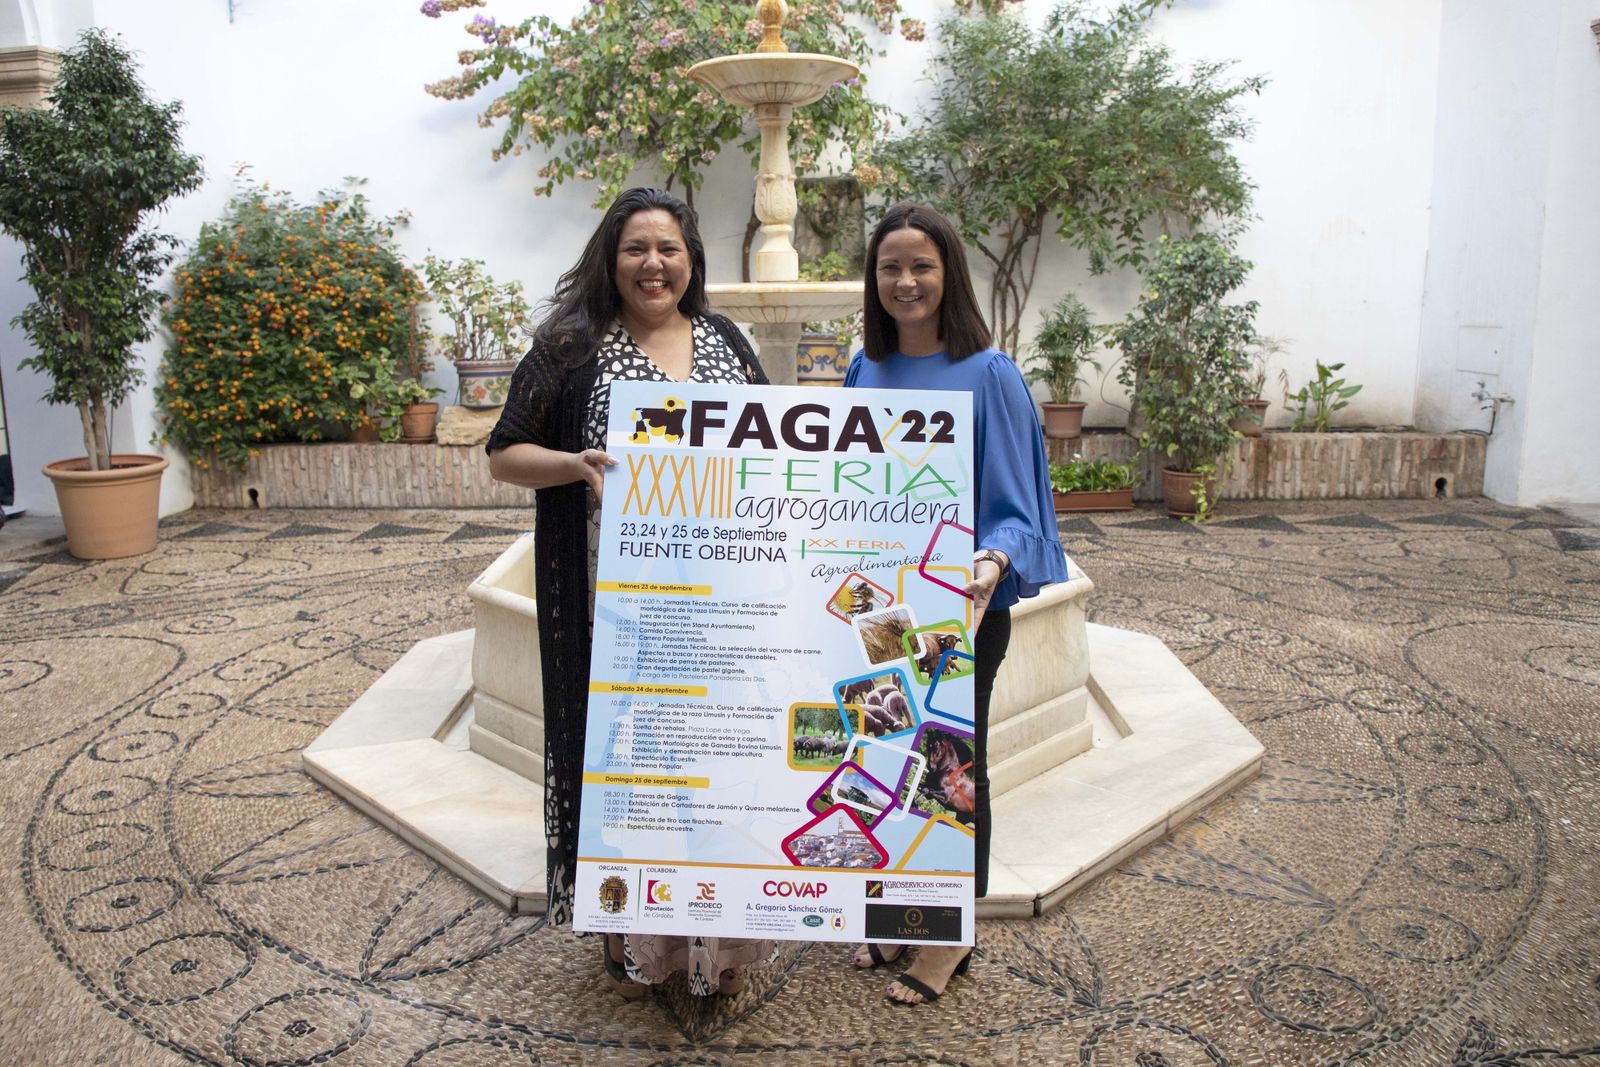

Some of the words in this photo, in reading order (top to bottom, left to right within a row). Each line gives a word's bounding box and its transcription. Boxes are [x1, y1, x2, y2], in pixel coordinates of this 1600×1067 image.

[689, 400, 885, 453] FAGA
[622, 454, 733, 519] XXXVIII
[736, 458, 959, 497] FERIA
[735, 493, 960, 530] agroganadera
[620, 522, 656, 538] 23,24
[660, 527, 668, 541] y
[672, 524, 688, 539] 25
[691, 525, 710, 540] de
[713, 526, 787, 545] Septiembre
[846, 540, 906, 551] FERIA
[619, 541, 692, 560] FUENTE
[698, 544, 787, 563] OBEJUNA
[811, 552, 944, 583] Agroalimentaria
[640, 605, 676, 613] morfológica
[639, 620, 679, 628] Inauguración
[710, 623, 755, 631] Ayuntamiento)
[653, 664, 691, 673] degustación
[654, 686, 688, 694] septiembre
[633, 709, 670, 717] morfológica
[675, 733, 717, 741] reproducción
[663, 740, 699, 748] Morfológico
[631, 754, 669, 762] Espectáculo
[605, 776, 633, 784] Domingo
[653, 778, 688, 786] septiembre
[627, 823, 665, 831] Espectáculo
[763, 880, 828, 899] COVAP
[884, 880, 934, 890] AGROSERVICIOS
[755, 903, 786, 913] Gregorio
[788, 904, 818, 913] Sánchez
[819, 905, 843, 914] Gómez
[898, 927, 912, 935] LAS
[914, 927, 930, 936] DOS
